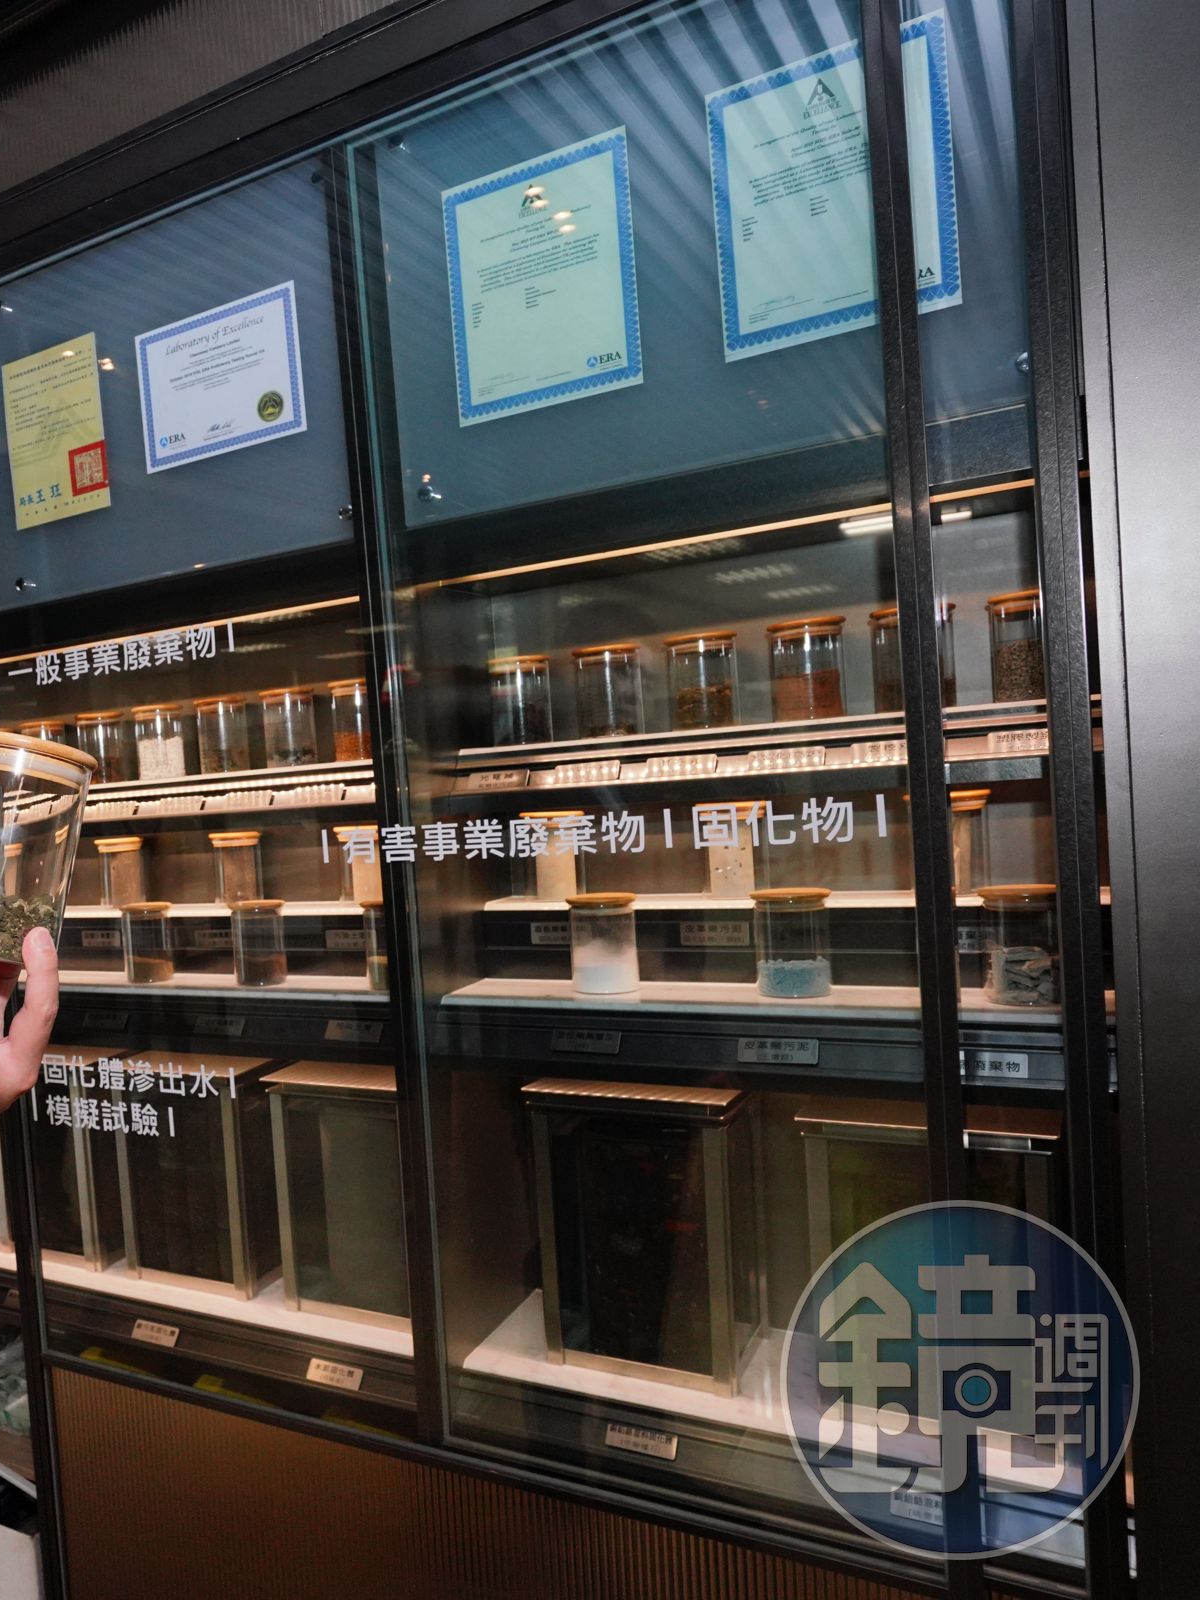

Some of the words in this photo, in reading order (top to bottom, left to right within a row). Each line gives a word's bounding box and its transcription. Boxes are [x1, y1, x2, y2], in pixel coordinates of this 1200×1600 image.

[165, 333, 210, 356] Laboratory
[211, 328, 222, 342] of
[222, 316, 265, 337] Excellence
[599, 351, 622, 364] ERA
[169, 432, 186, 443] ERA
[8, 623, 216, 686] 一般事業廢棄物
[342, 810, 645, 864] 有害事業廢棄物
[692, 796, 854, 849] 固化物
[41, 1053, 220, 1099] 固化體滲出水
[46, 1094, 160, 1137] 模擬試驗
